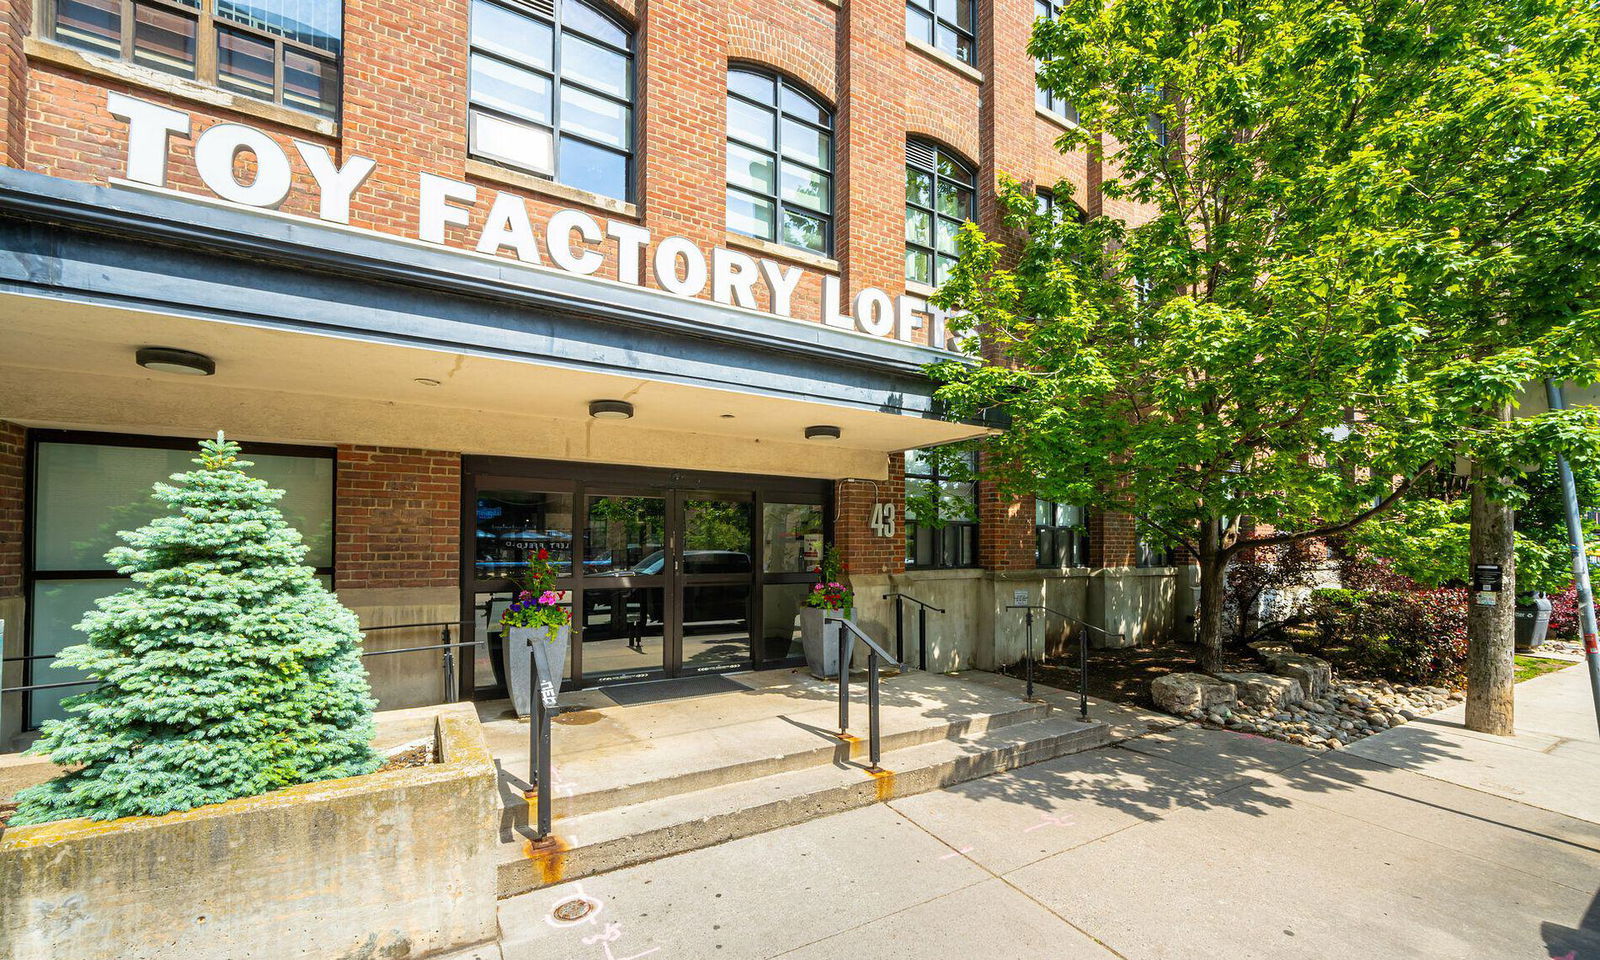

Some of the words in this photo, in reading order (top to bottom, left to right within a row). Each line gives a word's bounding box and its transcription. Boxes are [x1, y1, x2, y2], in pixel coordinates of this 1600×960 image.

[107, 91, 376, 224] TOY
[420, 172, 804, 317] FACTORY
[871, 503, 895, 537] 43
